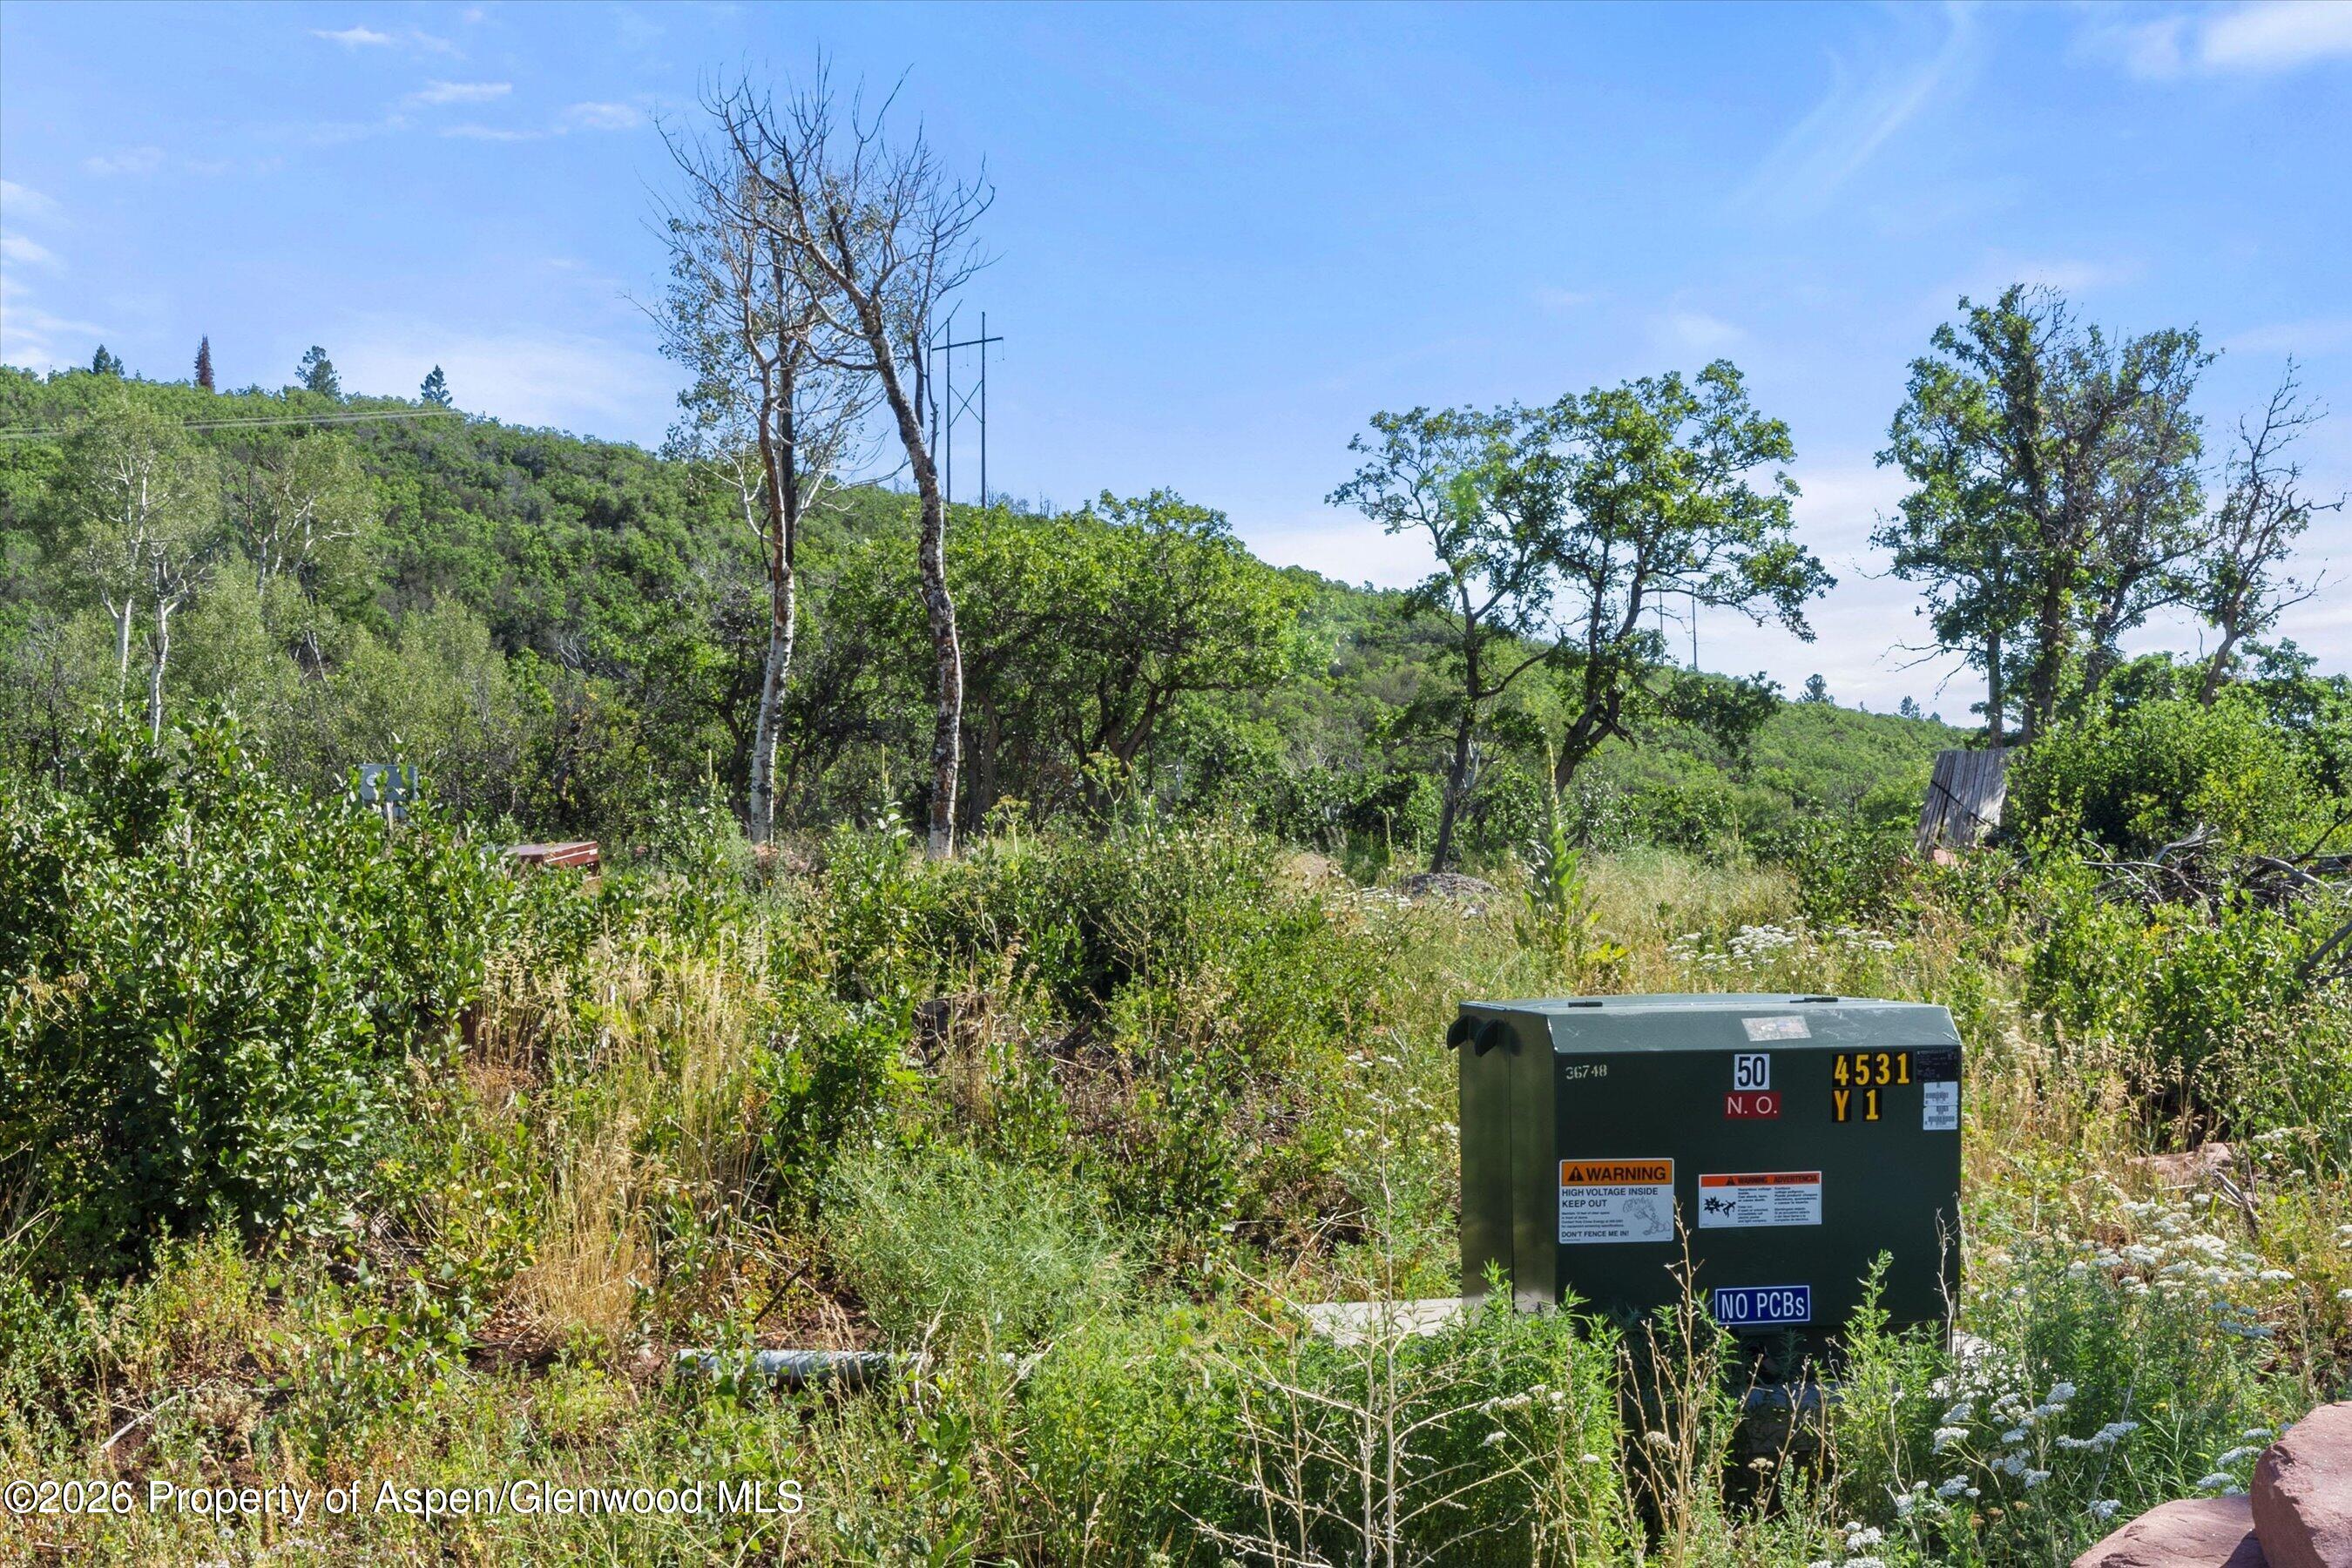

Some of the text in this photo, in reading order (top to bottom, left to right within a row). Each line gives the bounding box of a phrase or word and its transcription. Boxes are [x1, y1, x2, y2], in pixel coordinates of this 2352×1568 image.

[1565, 1064, 1607, 1079] 36748
[1737, 1056, 1766, 1087] 50
[1834, 1052, 1909, 1086] 4531
[1834, 1089, 1878, 1122] Y 1
[1586, 1166, 1666, 1181] WARNING
[1561, 1188, 1584, 1197] HIGH
[1586, 1187, 1625, 1196] VOLTAGE
[1721, 1291, 1805, 1319] NO PCBs
